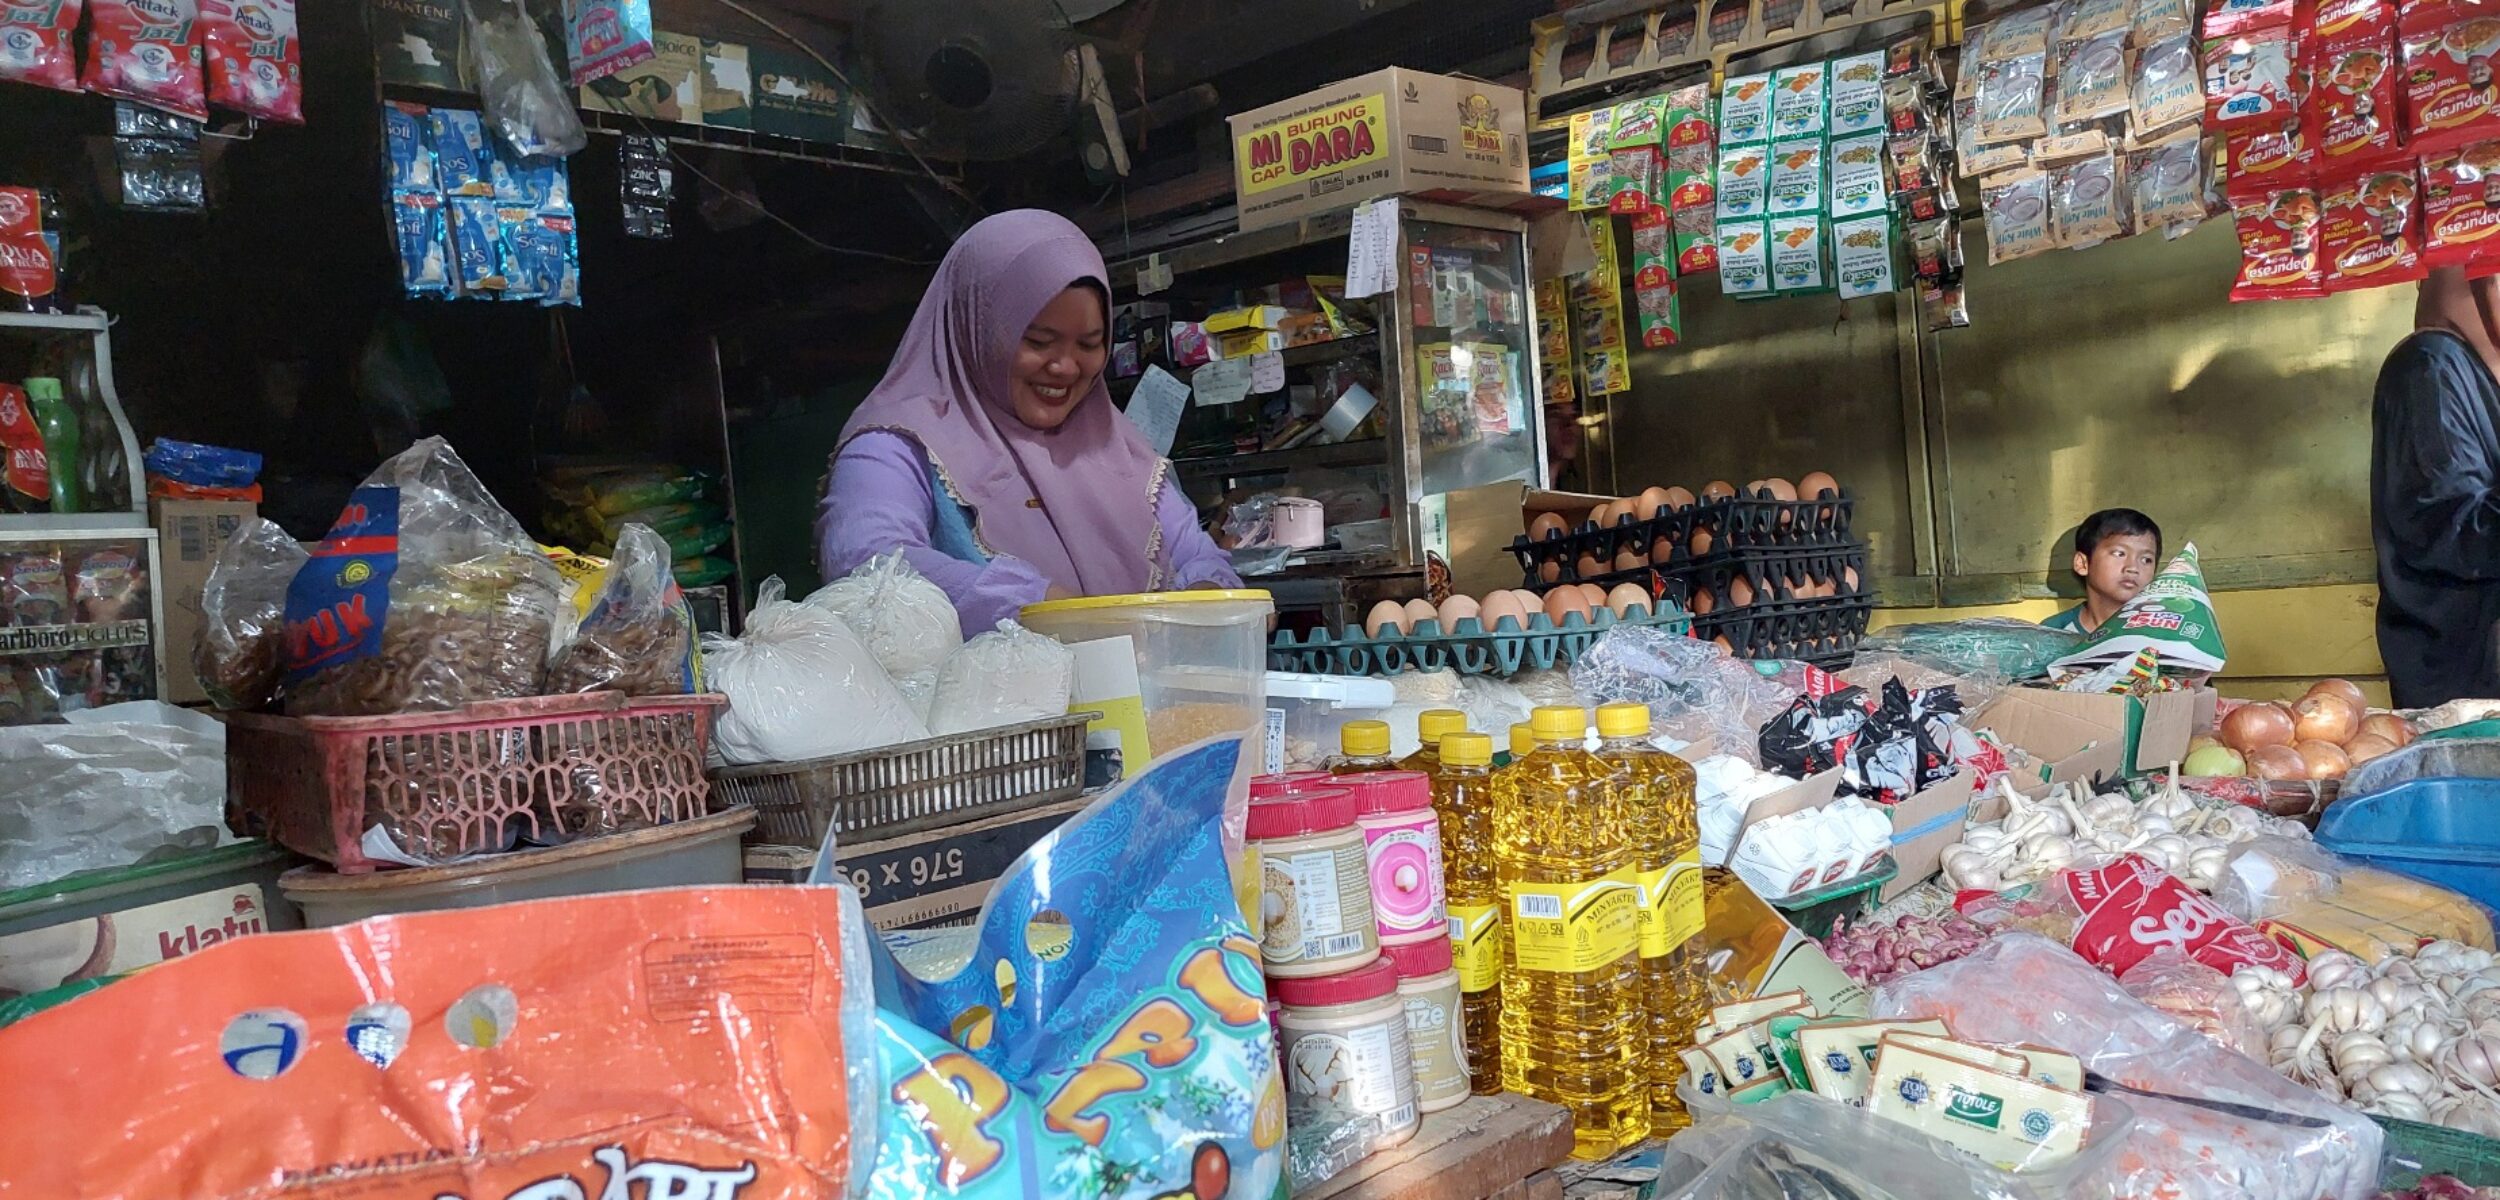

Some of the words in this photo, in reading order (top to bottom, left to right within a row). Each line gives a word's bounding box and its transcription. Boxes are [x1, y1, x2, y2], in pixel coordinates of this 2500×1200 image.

[130, 17, 194, 46] Jaz1
[234, 5, 273, 33] Attack
[249, 34, 287, 61] Jaz1
[2166, 81, 2195, 100] White
[2227, 96, 2262, 113] Zee
[2425, 89, 2491, 123] Dapurasa
[1286, 104, 1367, 138] BURUNG
[1615, 113, 1658, 142] Masako
[1249, 130, 1283, 170] MI
[1288, 119, 1376, 176] DARA
[2242, 139, 2299, 167] Dapurasa
[631, 169, 656, 182] ZINC
[1251, 164, 1286, 184] CAP
[2166, 191, 2194, 206] White
[2081, 206, 2107, 220] White
[2018, 226, 2042, 239] White
[2248, 256, 2310, 279] Dapurasa
[0, 627, 70, 651] arlboro
[71, 623, 147, 643] LIGHTS
[880, 861, 901, 887] x
[908, 848, 964, 888] 576
[1585, 893, 1637, 925] MINYAKITA
[1956, 1092, 1998, 1112] TOTOLE
